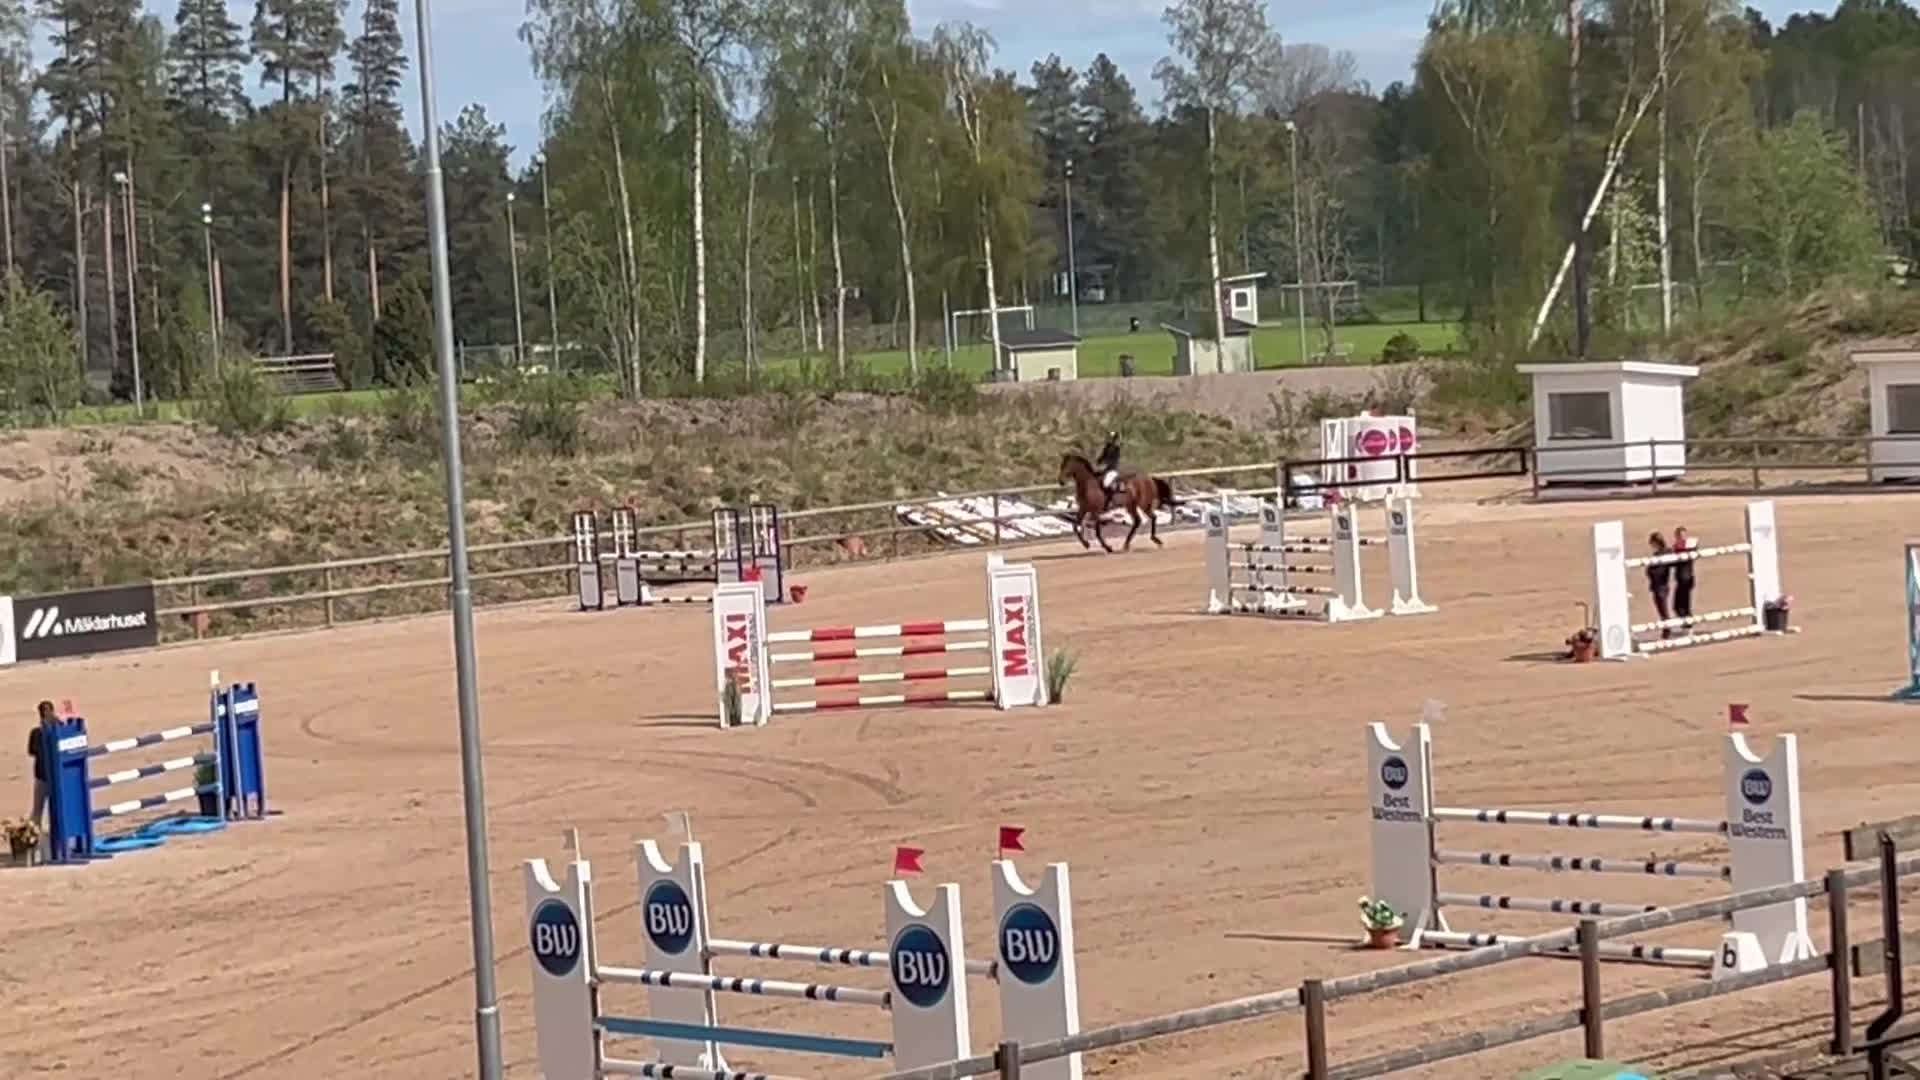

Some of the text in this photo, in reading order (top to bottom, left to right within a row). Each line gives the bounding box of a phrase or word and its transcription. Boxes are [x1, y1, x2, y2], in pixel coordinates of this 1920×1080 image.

[1003, 595, 1028, 677] MAXI
[725, 613, 751, 694] MAXI
[1383, 792, 1409, 808] Best
[1743, 808, 1773, 824] Best
[1730, 822, 1787, 840] Western
[650, 903, 689, 936] BW
[536, 923, 576, 957] BW
[1006, 929, 1054, 963] BW
[1722, 943, 1737, 968] b
[898, 950, 945, 986] BW
